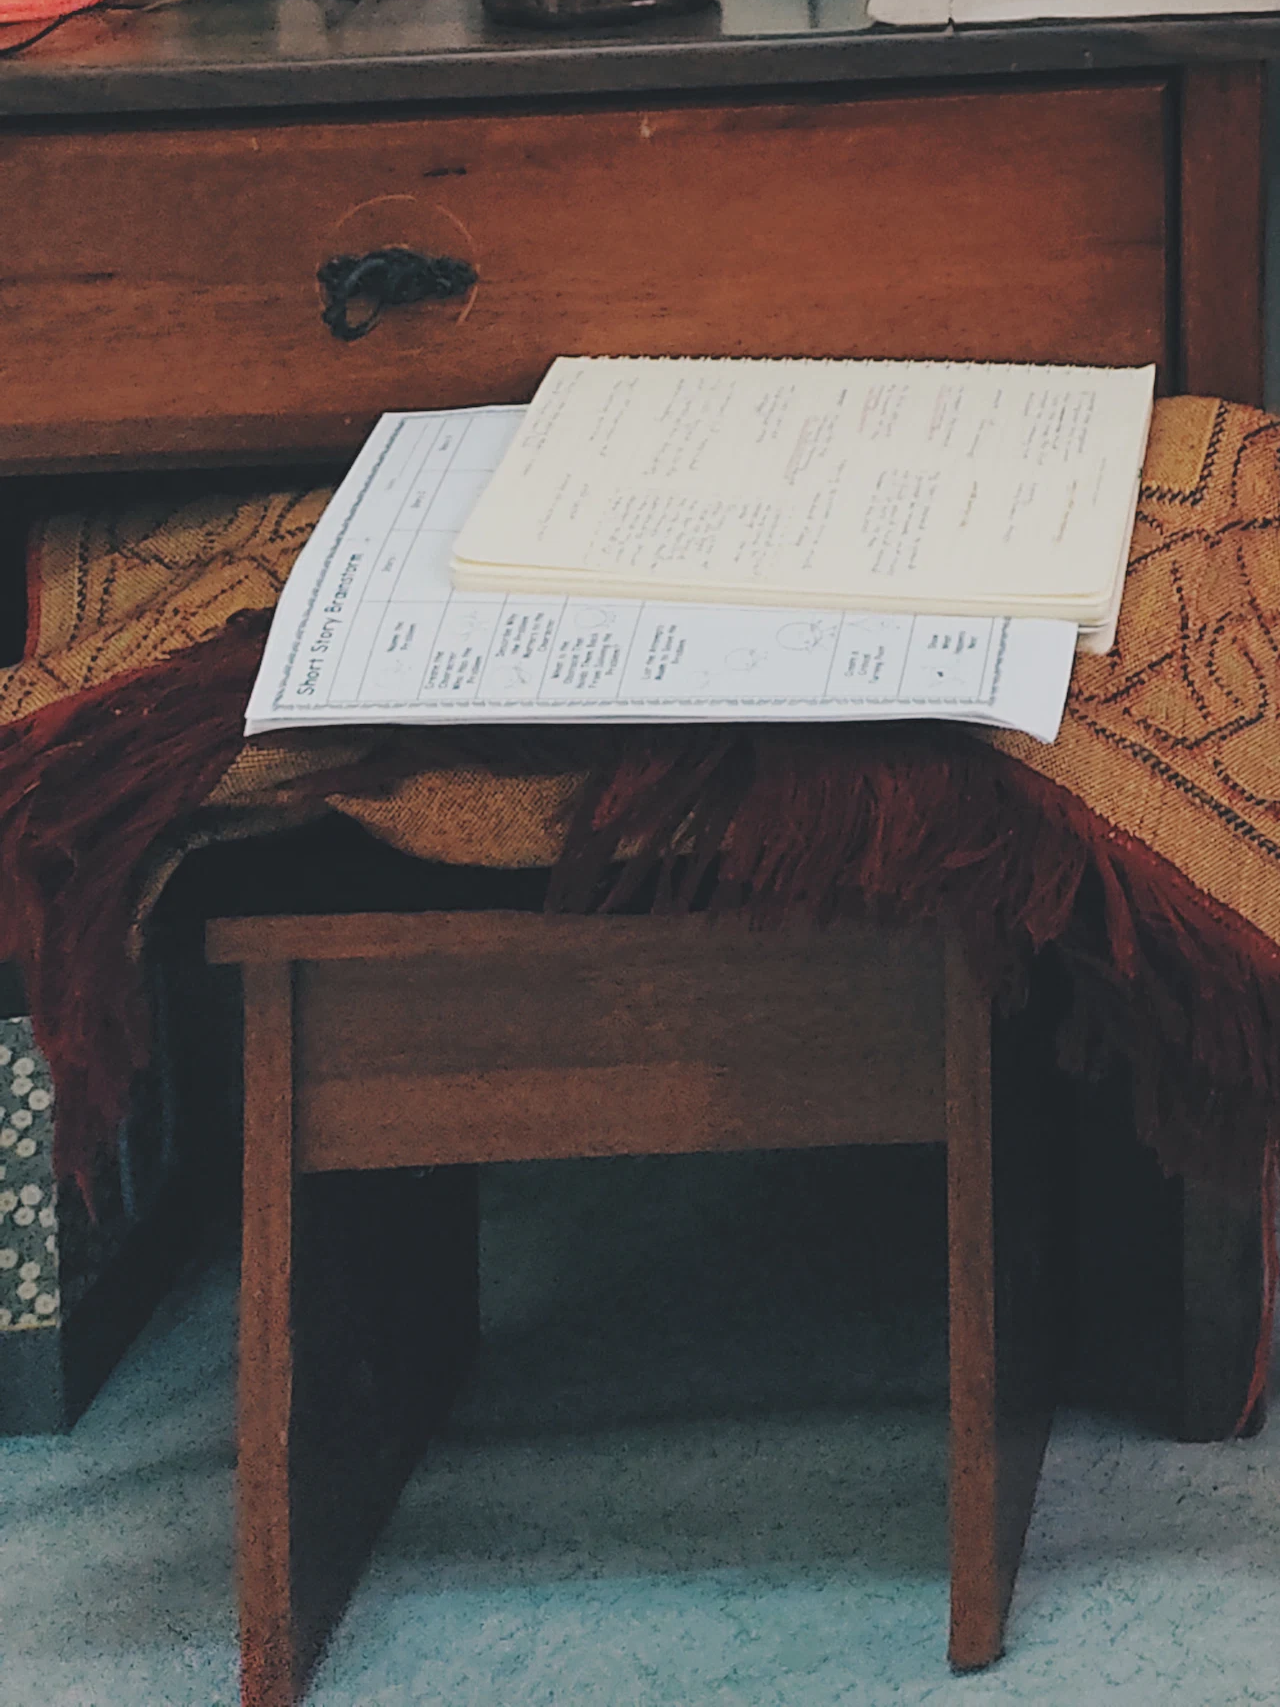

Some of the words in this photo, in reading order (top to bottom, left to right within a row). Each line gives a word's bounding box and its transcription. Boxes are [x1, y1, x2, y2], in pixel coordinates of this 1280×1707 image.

[325, 553, 362, 613] Brainstorm
[310, 617, 343, 653] Story
[297, 658, 325, 696] Short
